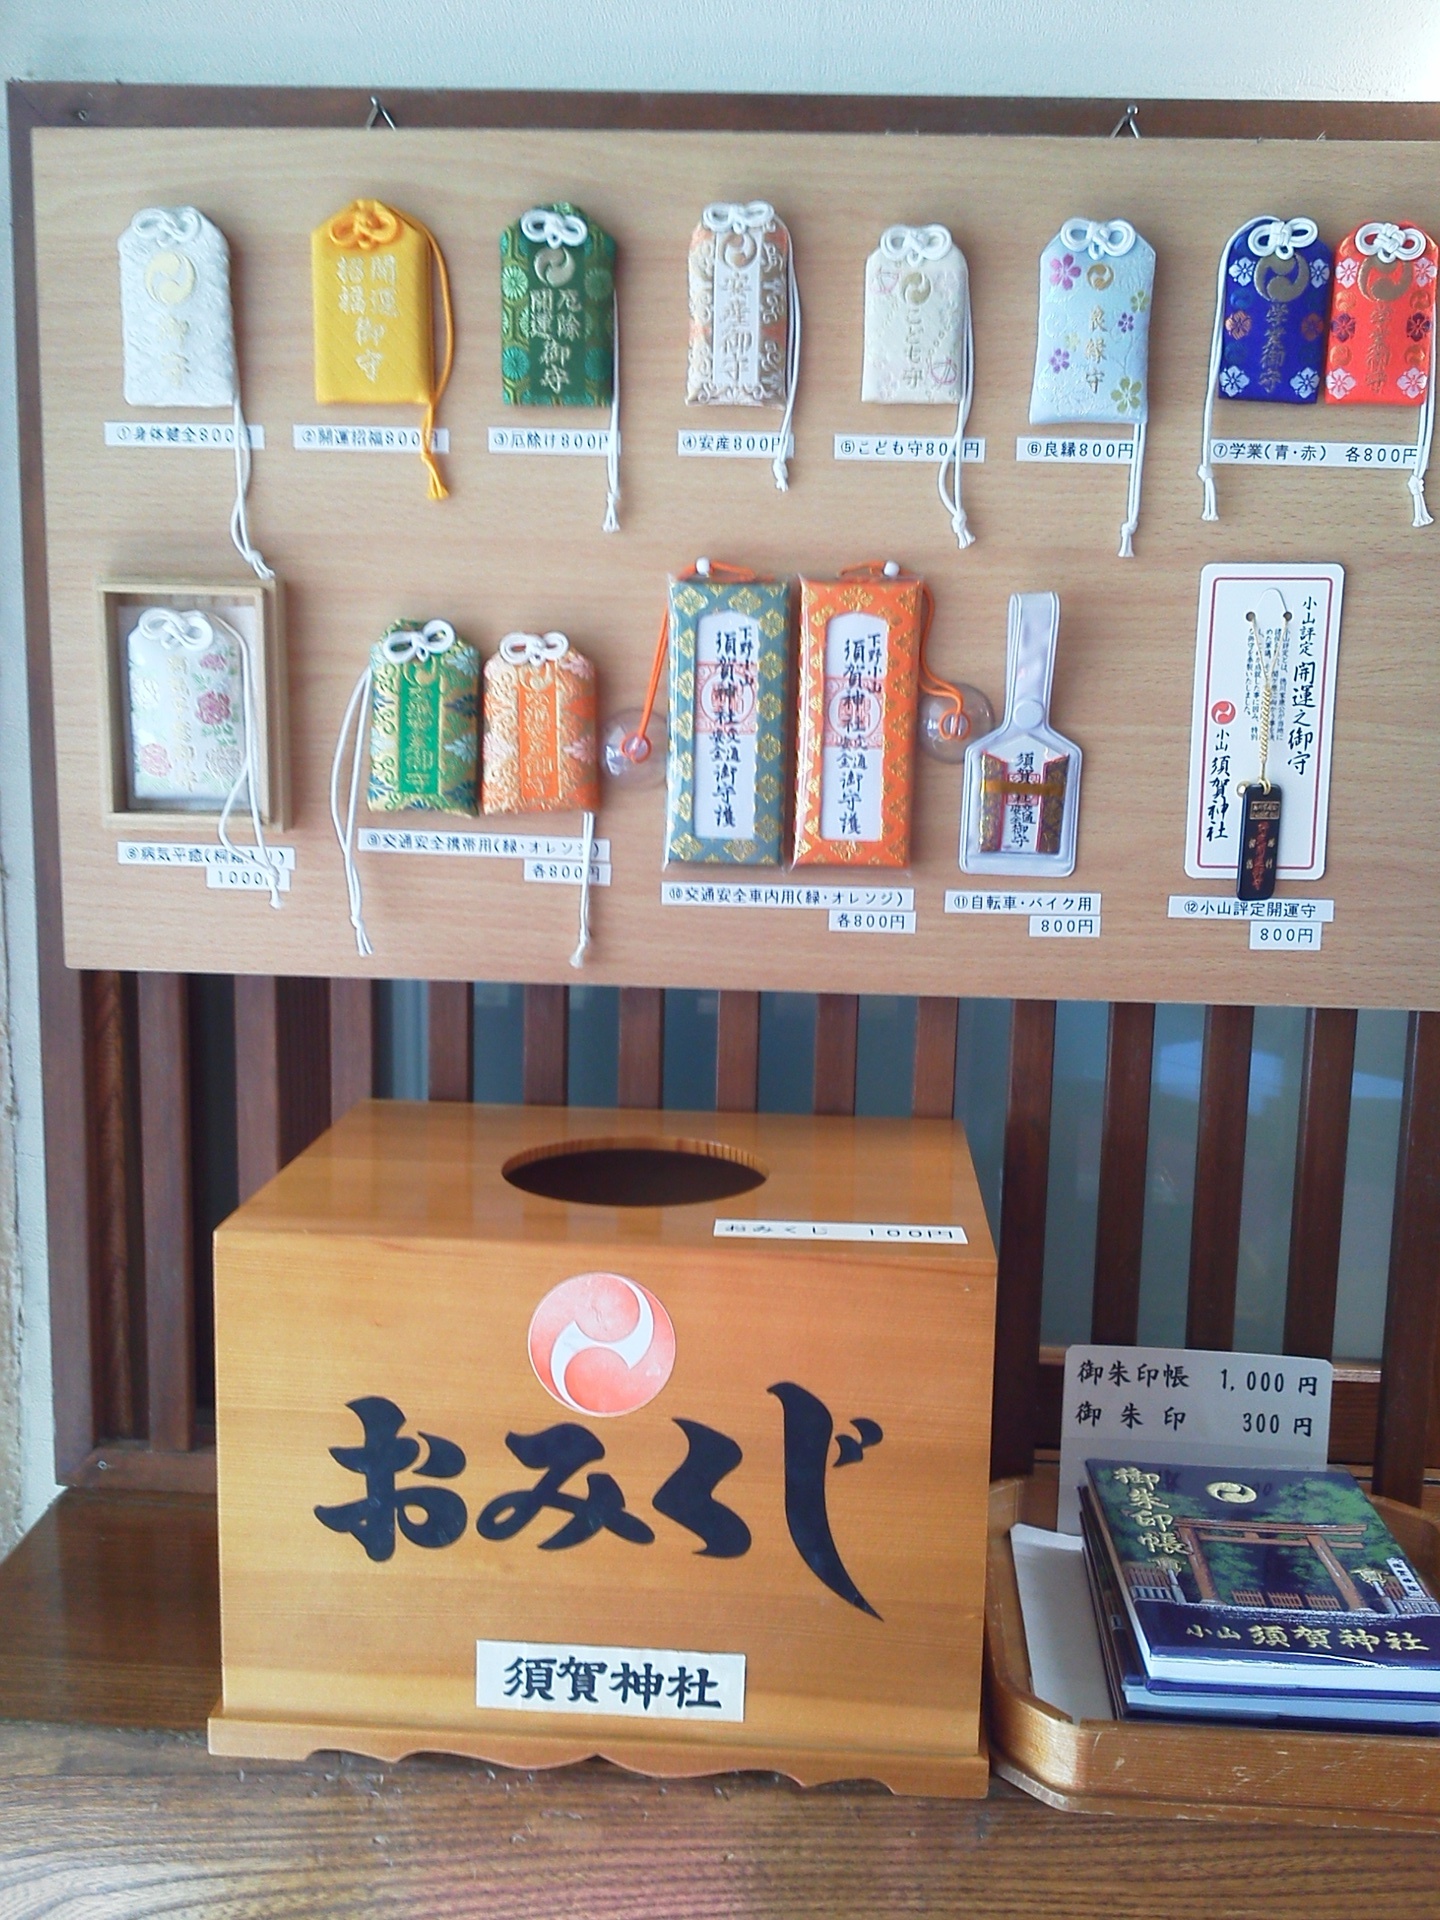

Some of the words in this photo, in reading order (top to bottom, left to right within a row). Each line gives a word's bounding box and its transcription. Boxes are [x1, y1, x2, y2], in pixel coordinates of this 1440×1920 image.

[539, 338, 571, 395] 御守
[1300, 595, 1318, 657] 小山評定
[716, 630, 737, 724] 須賀神社
[844, 638, 866, 733] 須賀神社
[867, 634, 883, 694] 下野小山
[1215, 728, 1230, 752] 小山
[1287, 663, 1317, 777] 開運之御守
[1206, 755, 1231, 842] 須賀神社
[837, 914, 906, 931] 各800円
[954, 894, 1092, 913] ⑪自転車・バイク用
[1184, 900, 1317, 918] ⑫小山評定開運守
[1041, 918, 1093, 935] 800円
[1260, 927, 1314, 944] 800円
[869, 1227, 954, 1240] 100円
[1077, 1359, 1190, 1388] 御朱印帳
[1242, 1411, 1280, 1435] 300
[314, 1381, 884, 1622] おみくじ
[1112, 1466, 1194, 1556] 御朱印帳
[1185, 1623, 1242, 1642] 小山
[1247, 1623, 1431, 1653] 須賀神社
[503, 1654, 723, 1711] 須賀神社
